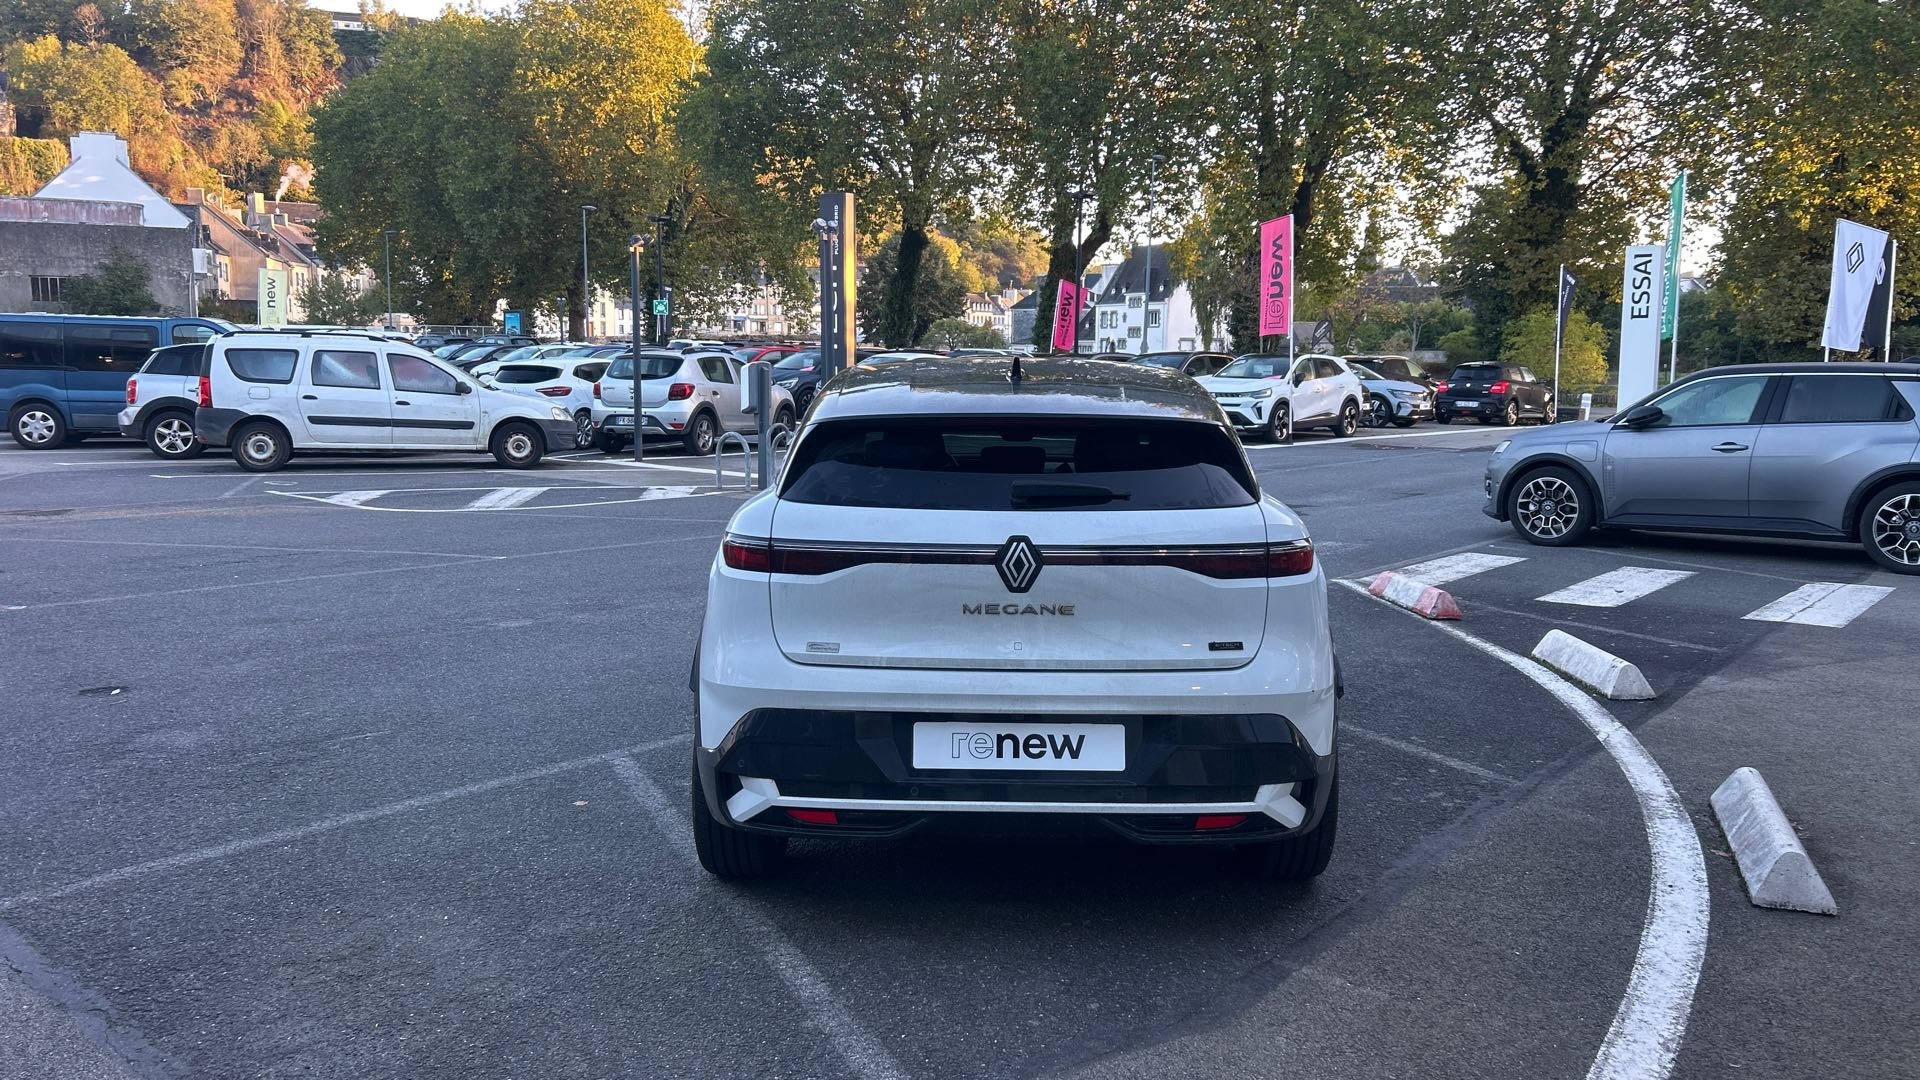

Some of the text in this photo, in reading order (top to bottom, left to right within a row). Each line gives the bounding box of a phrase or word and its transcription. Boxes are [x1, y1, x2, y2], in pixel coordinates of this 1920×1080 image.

[1630, 253, 1653, 320] ESSAI
[962, 603, 1076, 616] MEGANE
[951, 732, 1086, 760] renew
